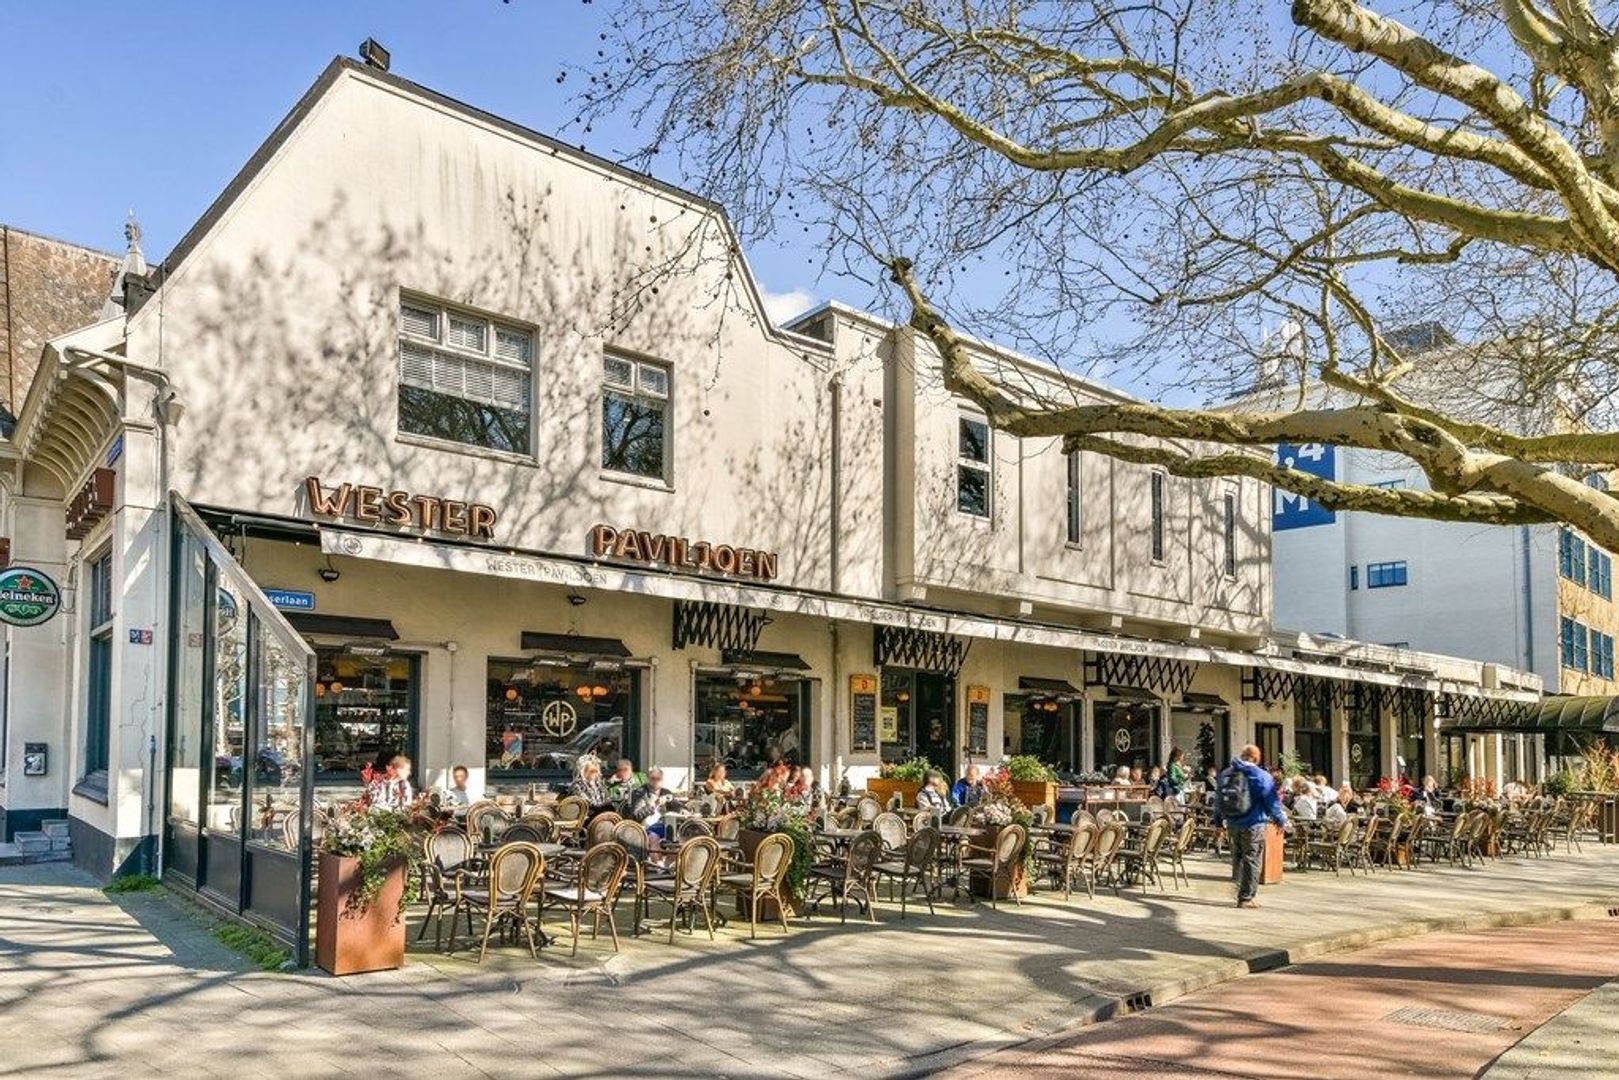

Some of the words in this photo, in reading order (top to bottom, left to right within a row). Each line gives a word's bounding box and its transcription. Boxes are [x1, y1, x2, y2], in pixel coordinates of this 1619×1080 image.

[306, 476, 497, 538] WESTER
[1275, 487, 1309, 515] M
[590, 523, 778, 580] PAVILJOEN
[486, 558, 536, 575] WESTER
[544, 566, 607, 585] PAVILJOEN
[0, 590, 54, 604] eineken
[269, 595, 308, 605] serlaan
